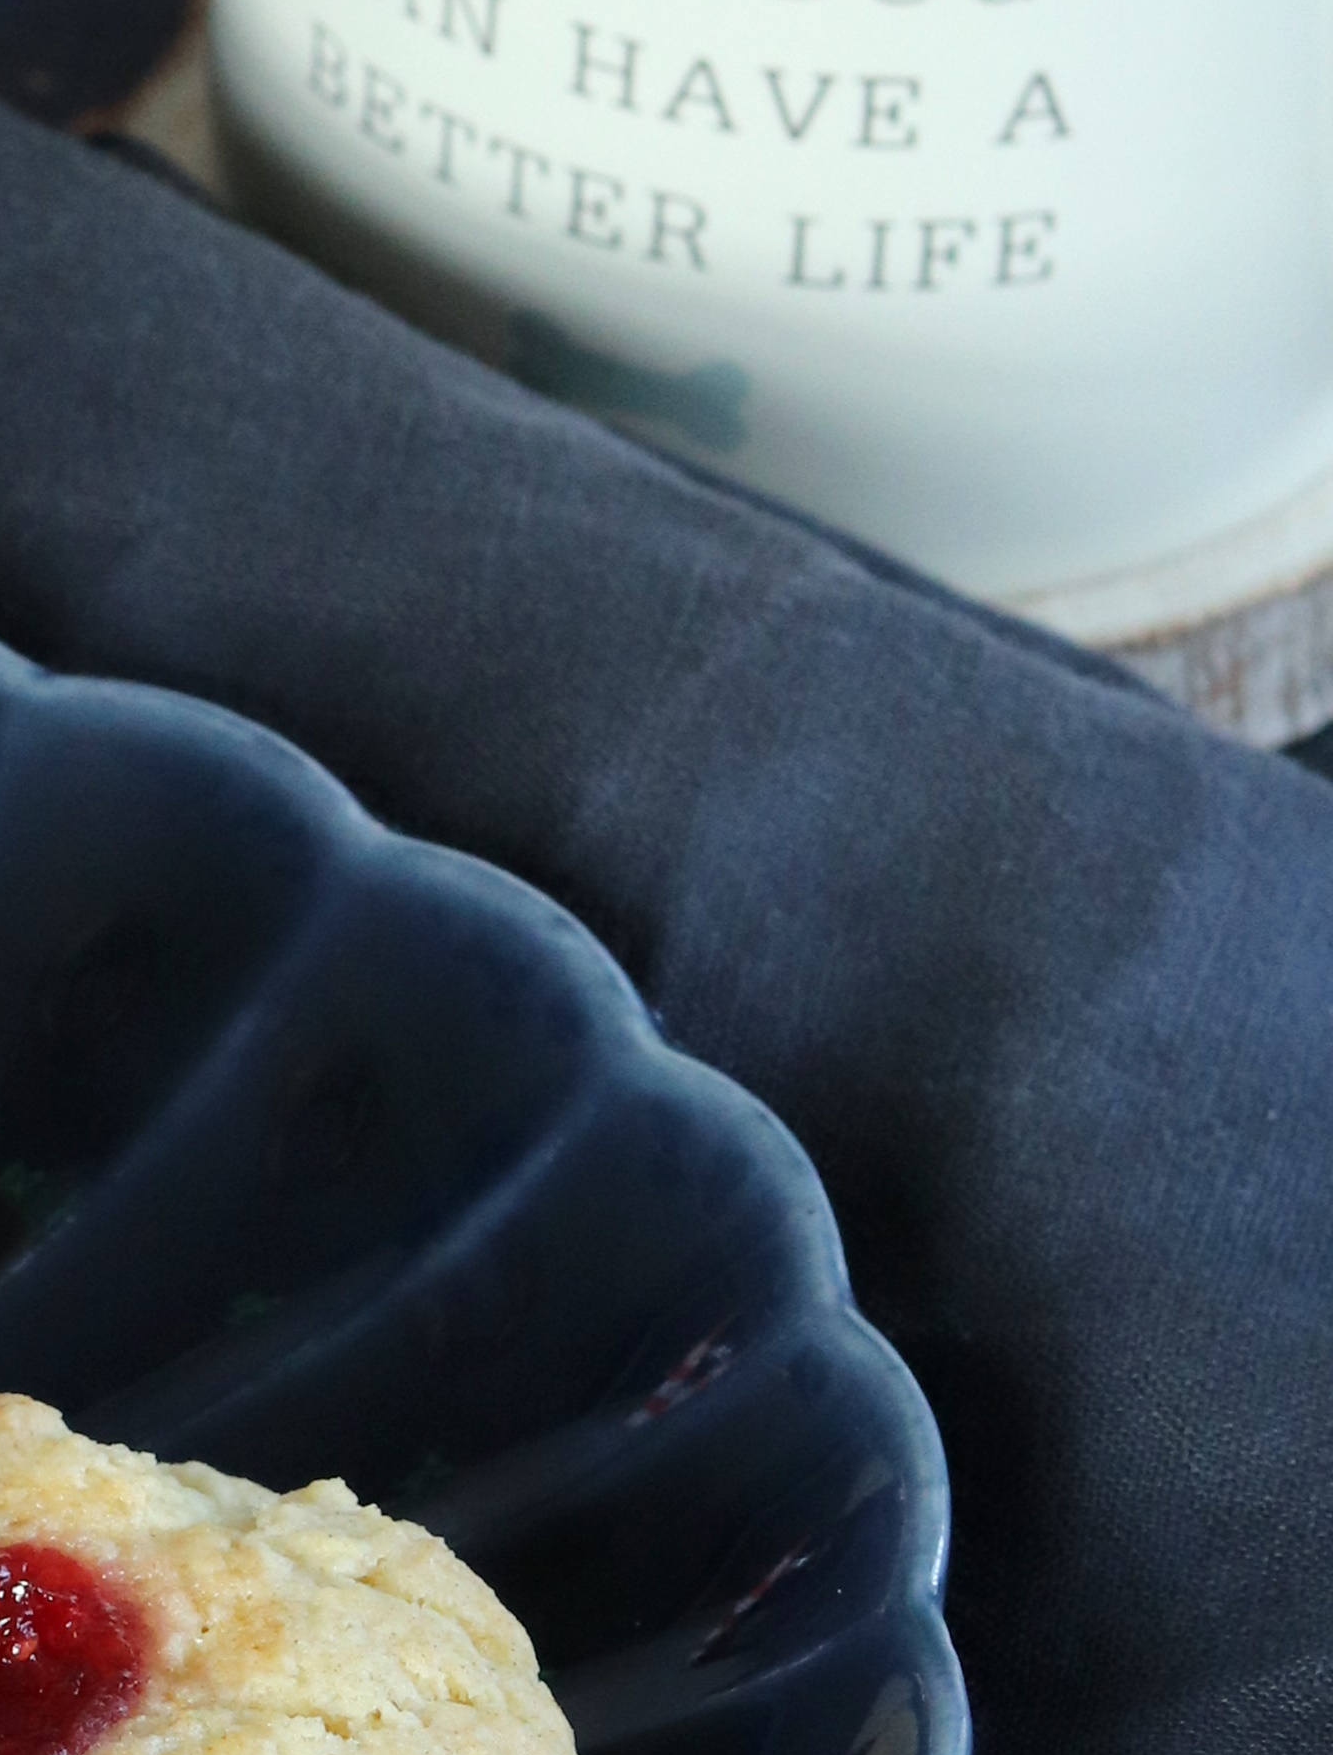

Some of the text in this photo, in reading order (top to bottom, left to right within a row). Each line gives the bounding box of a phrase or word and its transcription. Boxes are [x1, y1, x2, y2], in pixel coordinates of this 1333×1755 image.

[306, 18, 1057, 292] BETTER LIFE
[571, 19, 921, 149] HAVE
[994, 70, 1072, 147] A
